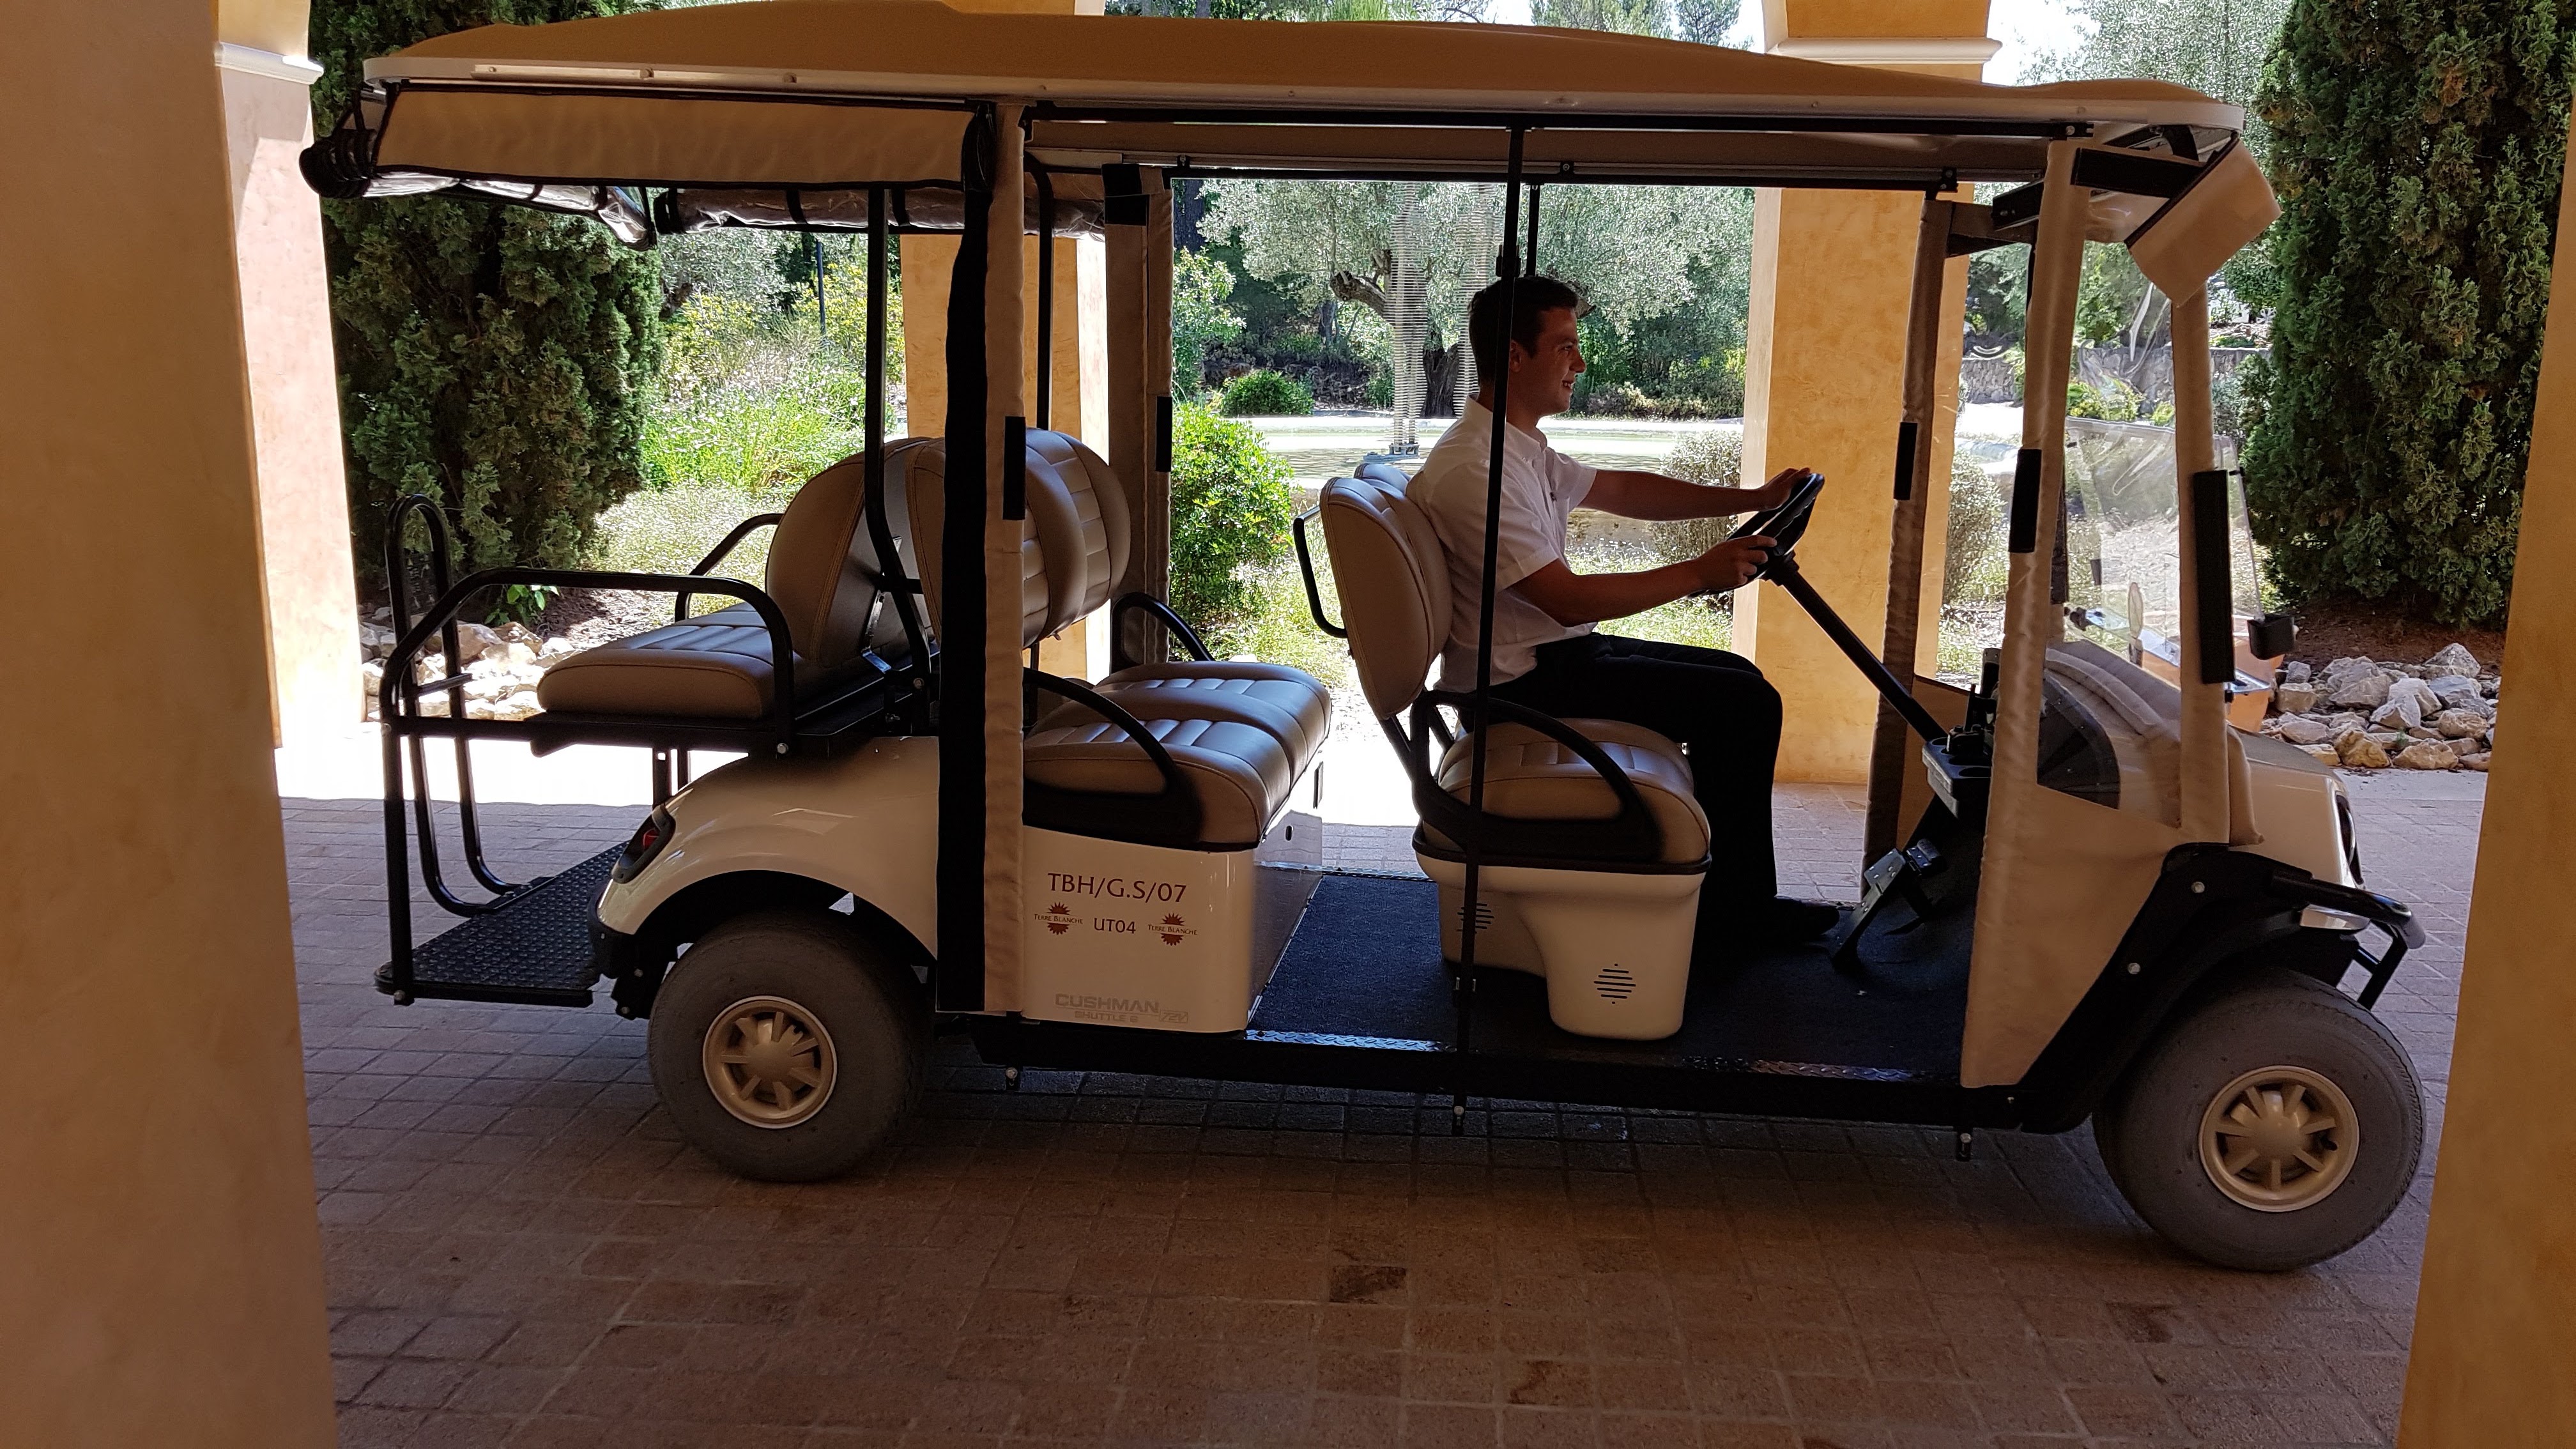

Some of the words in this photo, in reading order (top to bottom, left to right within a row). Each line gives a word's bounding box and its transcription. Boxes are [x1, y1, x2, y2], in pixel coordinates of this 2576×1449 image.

[1048, 873, 1186, 903] TBH/G.S/07
[1054, 916, 1084, 924] BLANCHE
[1094, 917, 1136, 934] UT04
[1167, 926, 1198, 935] BLANCHE
[1055, 993, 1160, 1013] CUSHMAN
[1075, 1010, 1126, 1022] SHUTTLE
